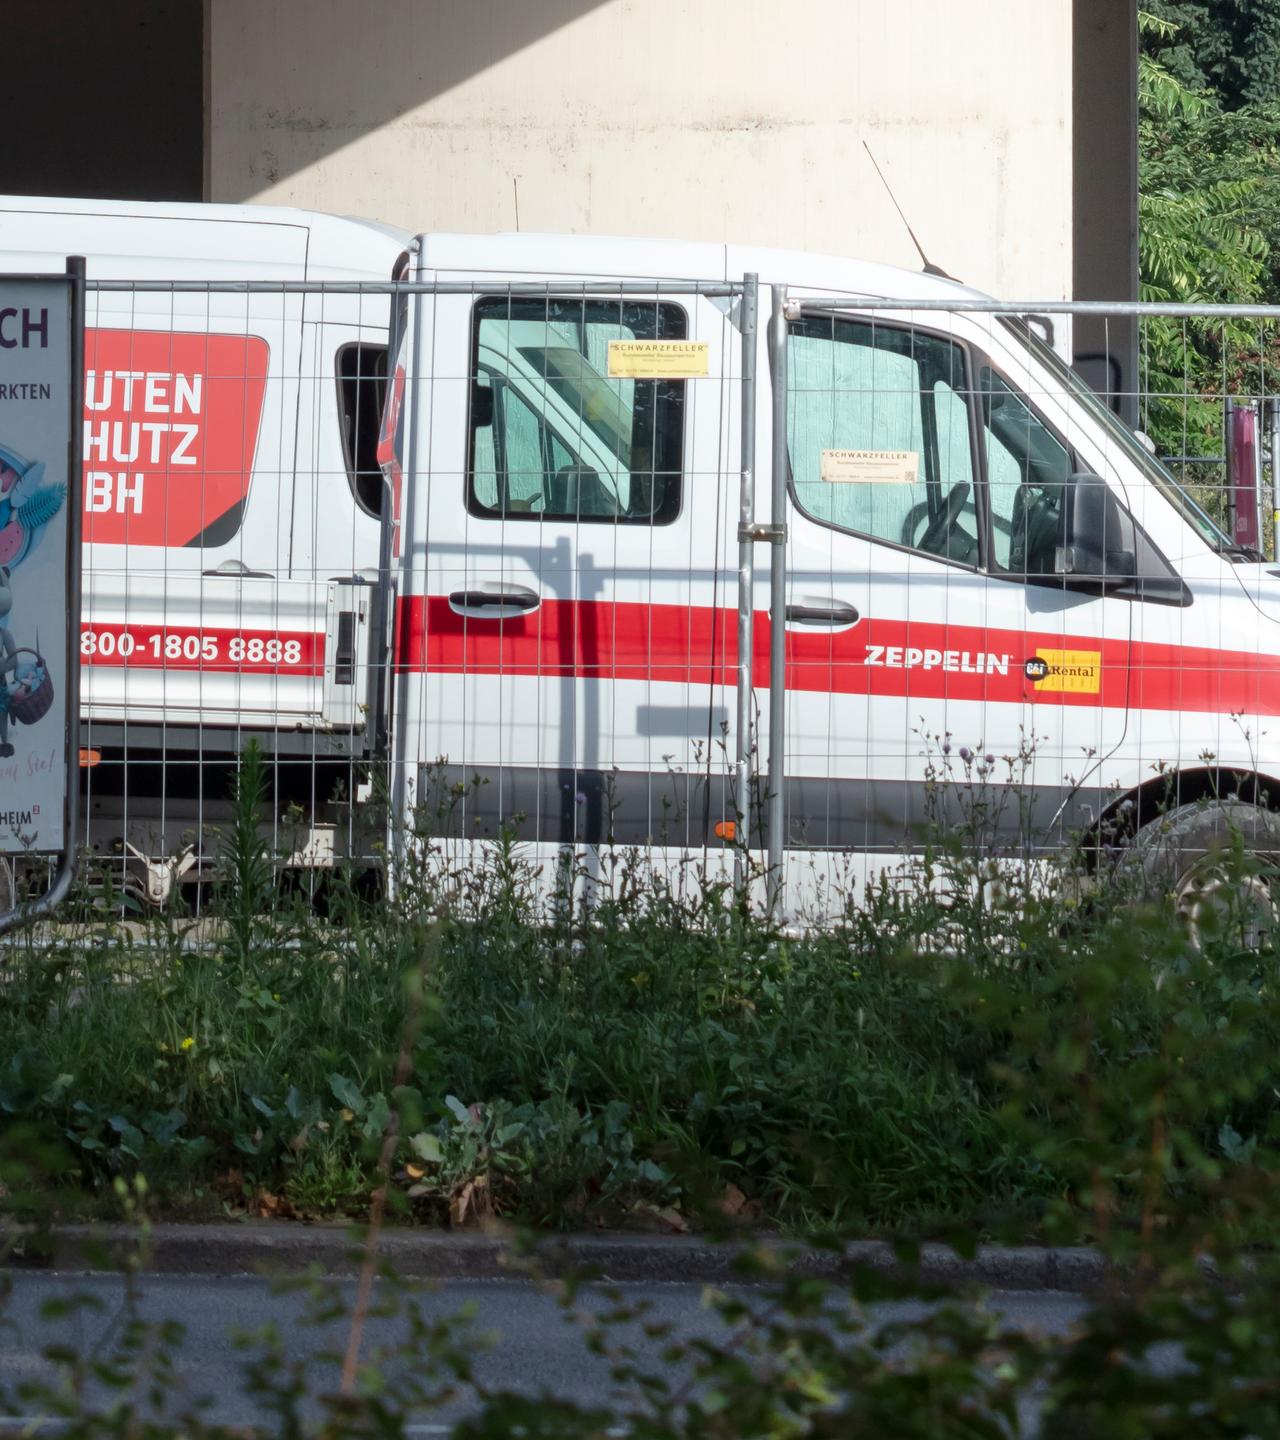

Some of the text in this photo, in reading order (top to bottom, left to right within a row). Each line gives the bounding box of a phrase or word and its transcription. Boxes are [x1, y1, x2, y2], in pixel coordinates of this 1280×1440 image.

[84, 370, 203, 414] UTEN
[83, 421, 199, 465] HUTZ
[85, 472, 145, 514] BH
[228, 637, 302, 664] 8888
[863, 644, 1010, 676] ZEPPELIN
[1051, 665, 1095, 678] Rental
